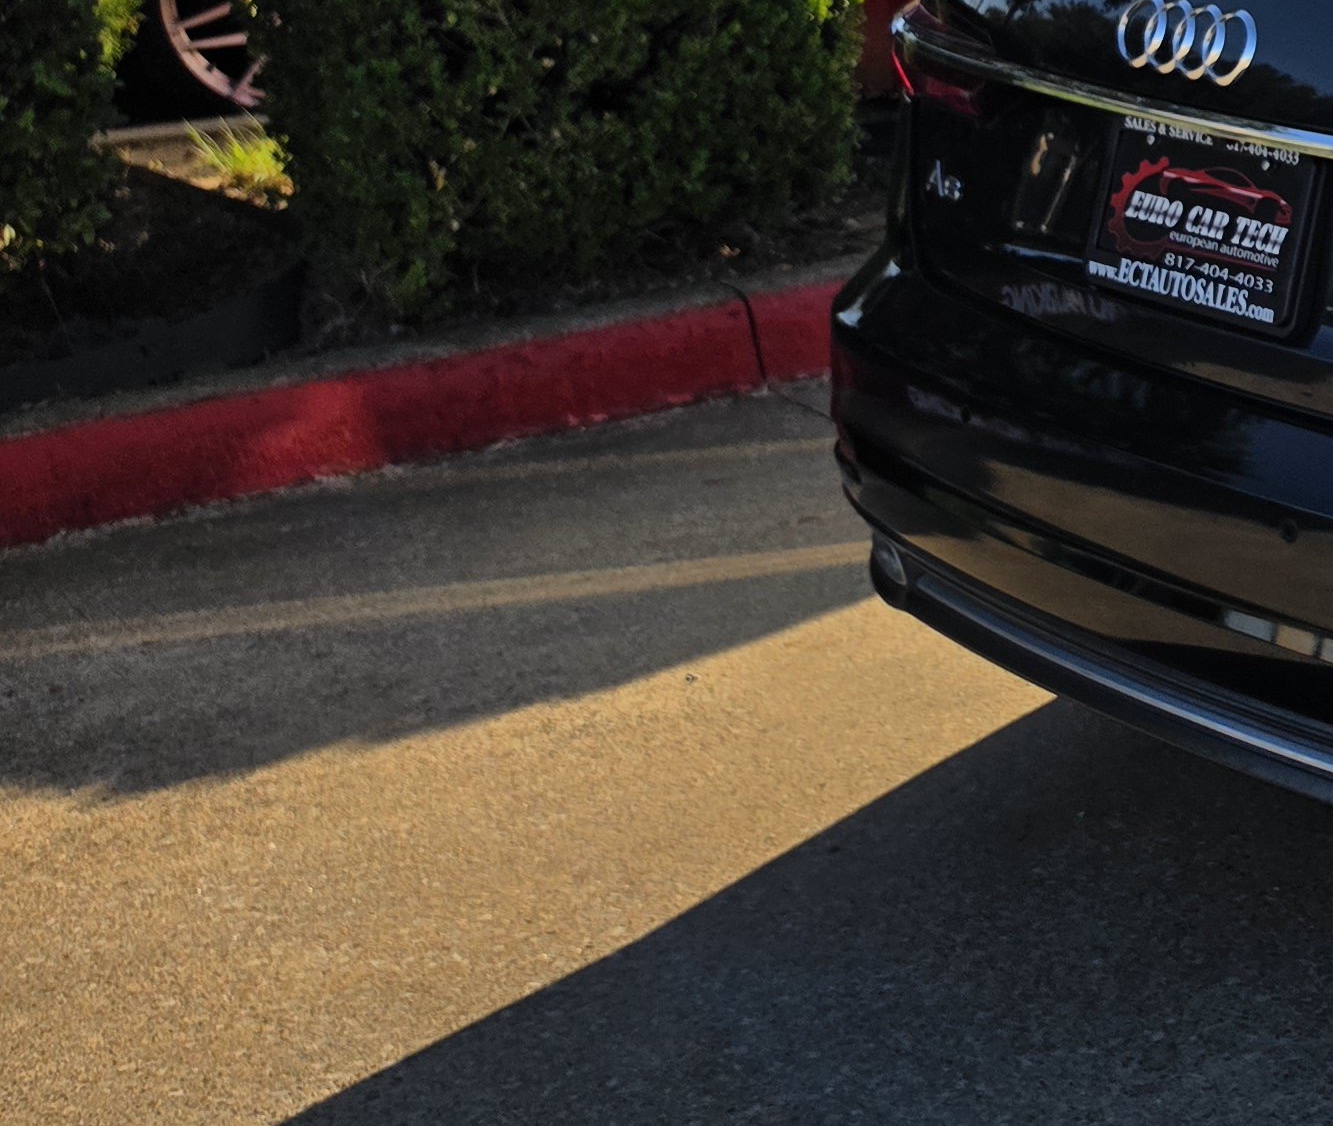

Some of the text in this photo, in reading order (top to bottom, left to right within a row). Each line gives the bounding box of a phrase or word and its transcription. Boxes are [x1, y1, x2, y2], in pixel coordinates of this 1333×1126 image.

[1124, 116, 1157, 133] SALES
[1124, 190, 1290, 255] EURO CAR TECH
[1168, 230, 1280, 268] european automotive
[1087, 258, 1275, 323] www.ECTAUTOSALES.com
[1163, 252, 1274, 294] 817-404-4033
